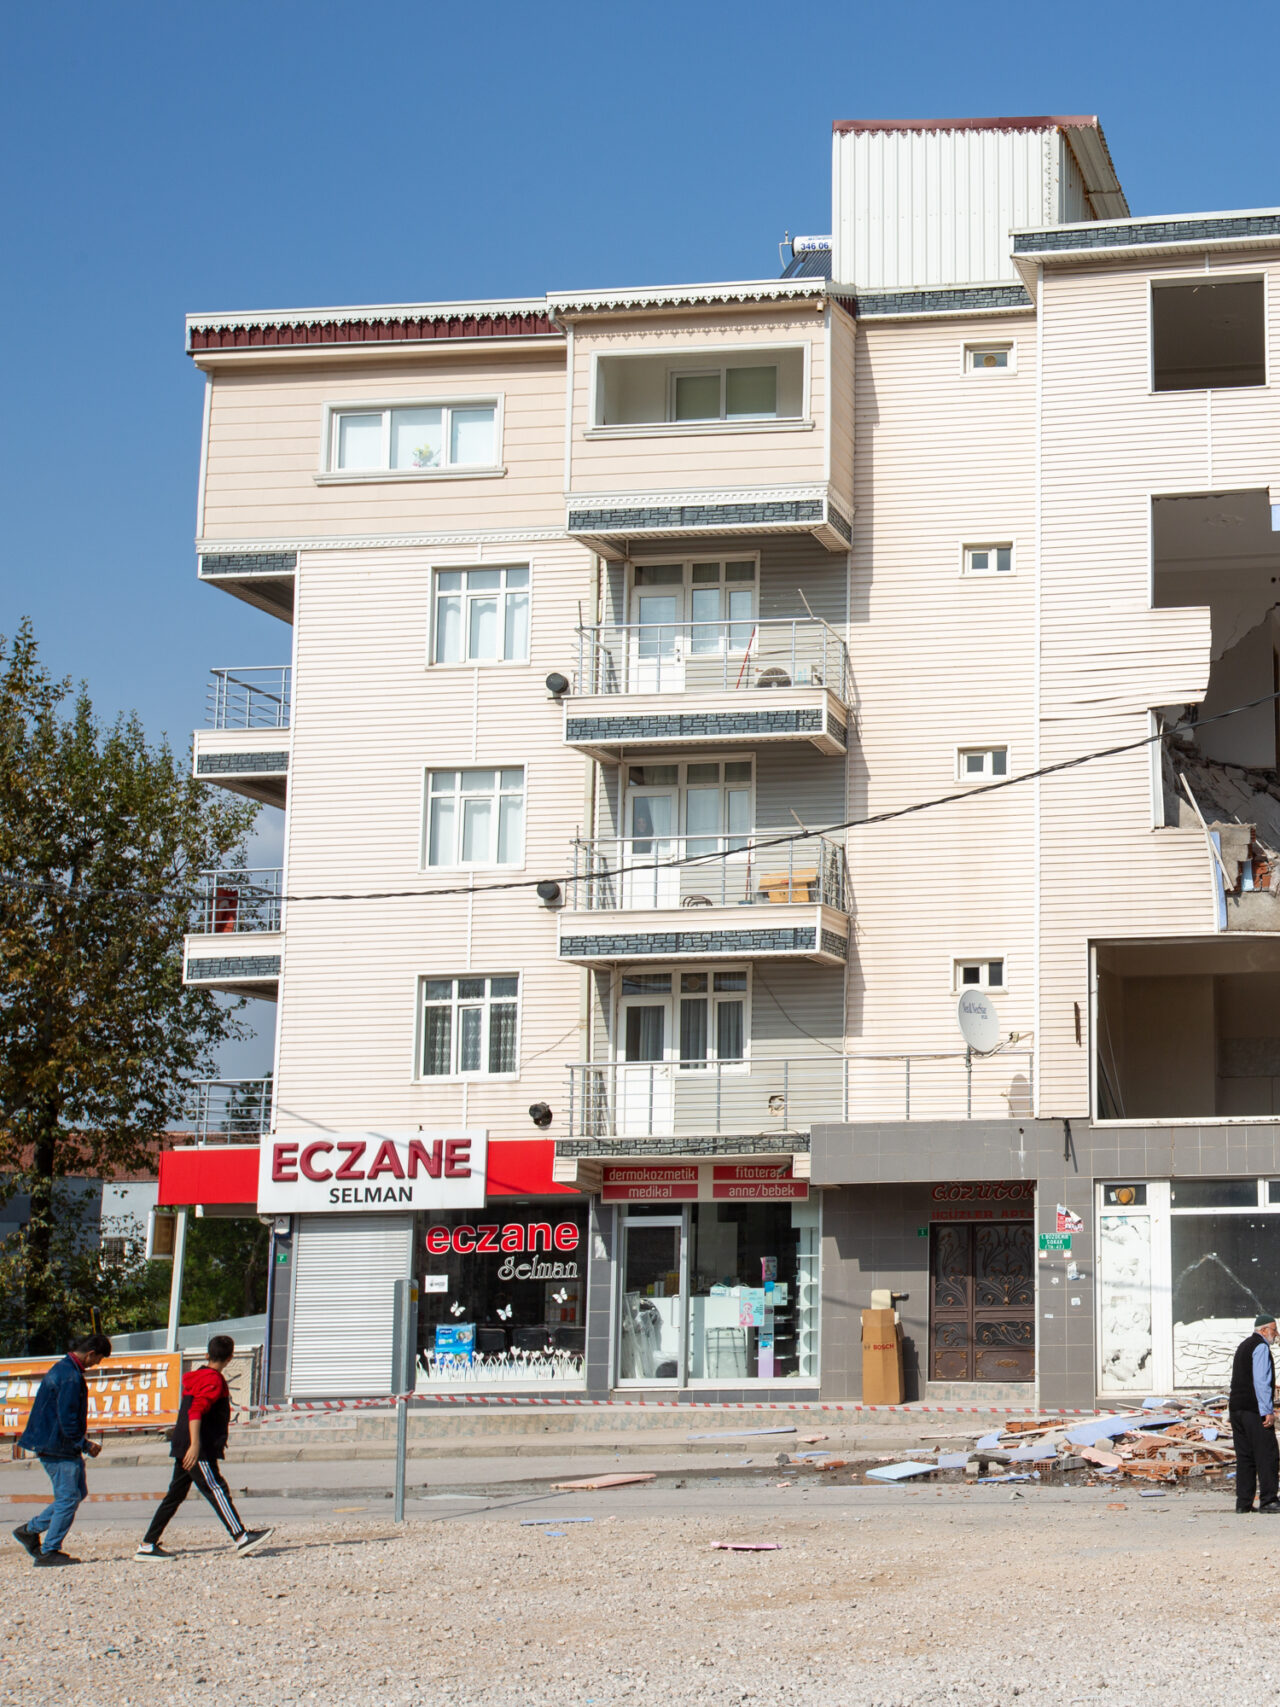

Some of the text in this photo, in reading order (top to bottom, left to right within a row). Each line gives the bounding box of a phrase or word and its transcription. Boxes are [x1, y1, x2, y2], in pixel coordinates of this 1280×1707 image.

[819, 242, 829, 250] 06
[272, 1138, 472, 1182] ECZANE
[609, 1168, 695, 1181] dermokozmetik
[329, 1186, 413, 1204] SELMAN
[628, 1185, 672, 1198] medikal
[729, 1184, 795, 1197] anne/bebek
[425, 1221, 579, 1255] eczane
[497, 1254, 578, 1281] Selman
[87, 1392, 161, 1419] AZARI
